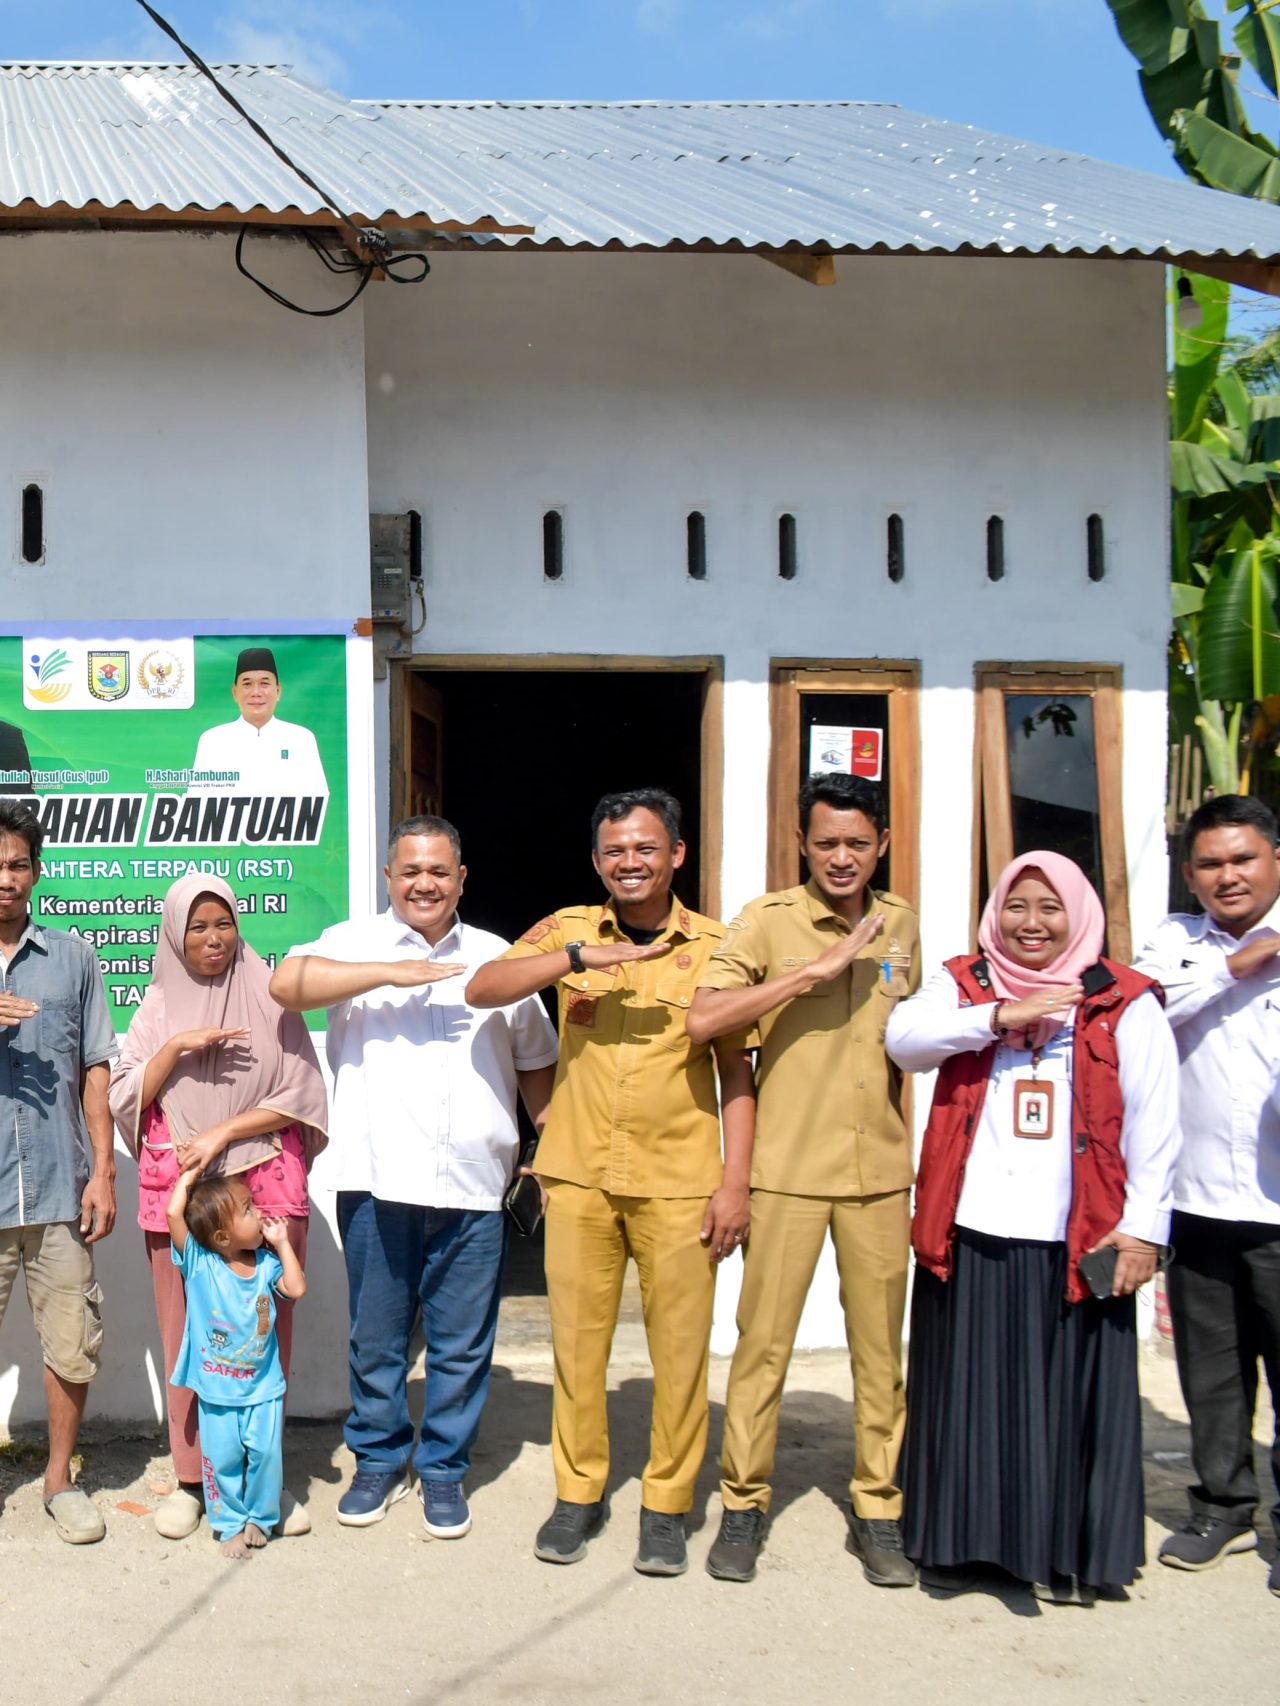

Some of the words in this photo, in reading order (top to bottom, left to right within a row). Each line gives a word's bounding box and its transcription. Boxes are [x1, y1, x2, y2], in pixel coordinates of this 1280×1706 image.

[31, 770, 59, 783] Yusuf
[61, 770, 83, 783] (Gus
[85, 770, 109, 784] Ipul)
[189, 770, 240, 782] Tambunan
[149, 797, 324, 844] BANTUAN
[130, 860, 230, 877] TERPADU
[237, 859, 293, 879] (RST)
[41, 896, 163, 914] Kementeria
[264, 895, 286, 913] RI
[70, 926, 158, 947] Aspirasi
[100, 956, 155, 973] omisi
[203, 1361, 256, 1379] SAHUR
